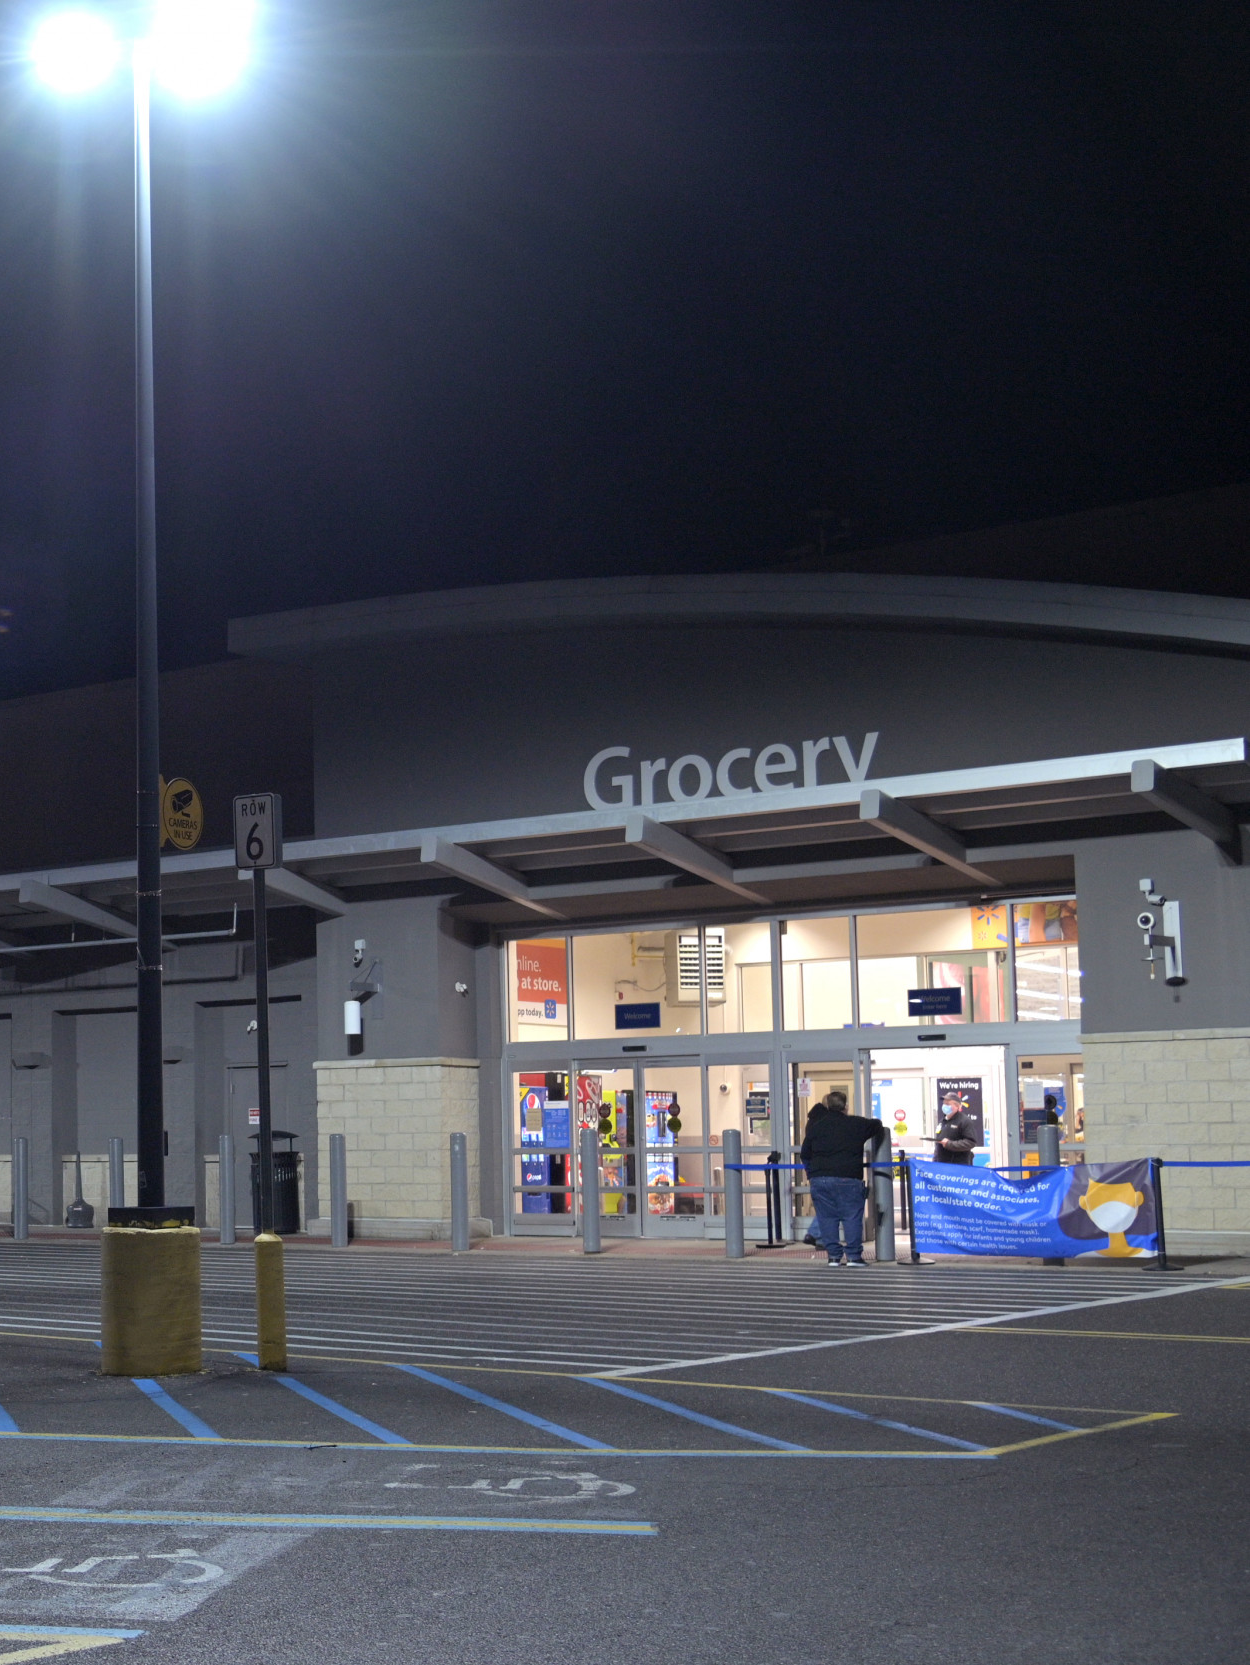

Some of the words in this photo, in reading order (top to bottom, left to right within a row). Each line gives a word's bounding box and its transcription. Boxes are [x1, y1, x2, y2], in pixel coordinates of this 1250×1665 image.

[584, 732, 878, 811] Grocery
[241, 801, 266, 816] ROW
[169, 818, 198, 830] CAMERAS
[182, 832, 193, 841] USE
[246, 822, 263, 861] 6
[517, 955, 541, 972] nline.
[521, 976, 531, 989] at
[533, 977, 561, 992] store.
[939, 1081, 958, 1089] We're
[959, 1081, 979, 1090] hiring
[915, 1168, 933, 1179] Face
[935, 1174, 979, 1186] coverings
[981, 1180, 996, 1188] are
[1037, 1182, 1050, 1191] for
[914, 1181, 925, 1190] all
[927, 1184, 969, 1195] customers
[971, 1188, 989, 1198] and
[990, 1193, 1040, 1203] associates.
[914, 1195, 930, 1204] per
[932, 1194, 972, 1207] local/state
[974, 1200, 1002, 1211] order.
[947, 1231, 963, 1239] apply
